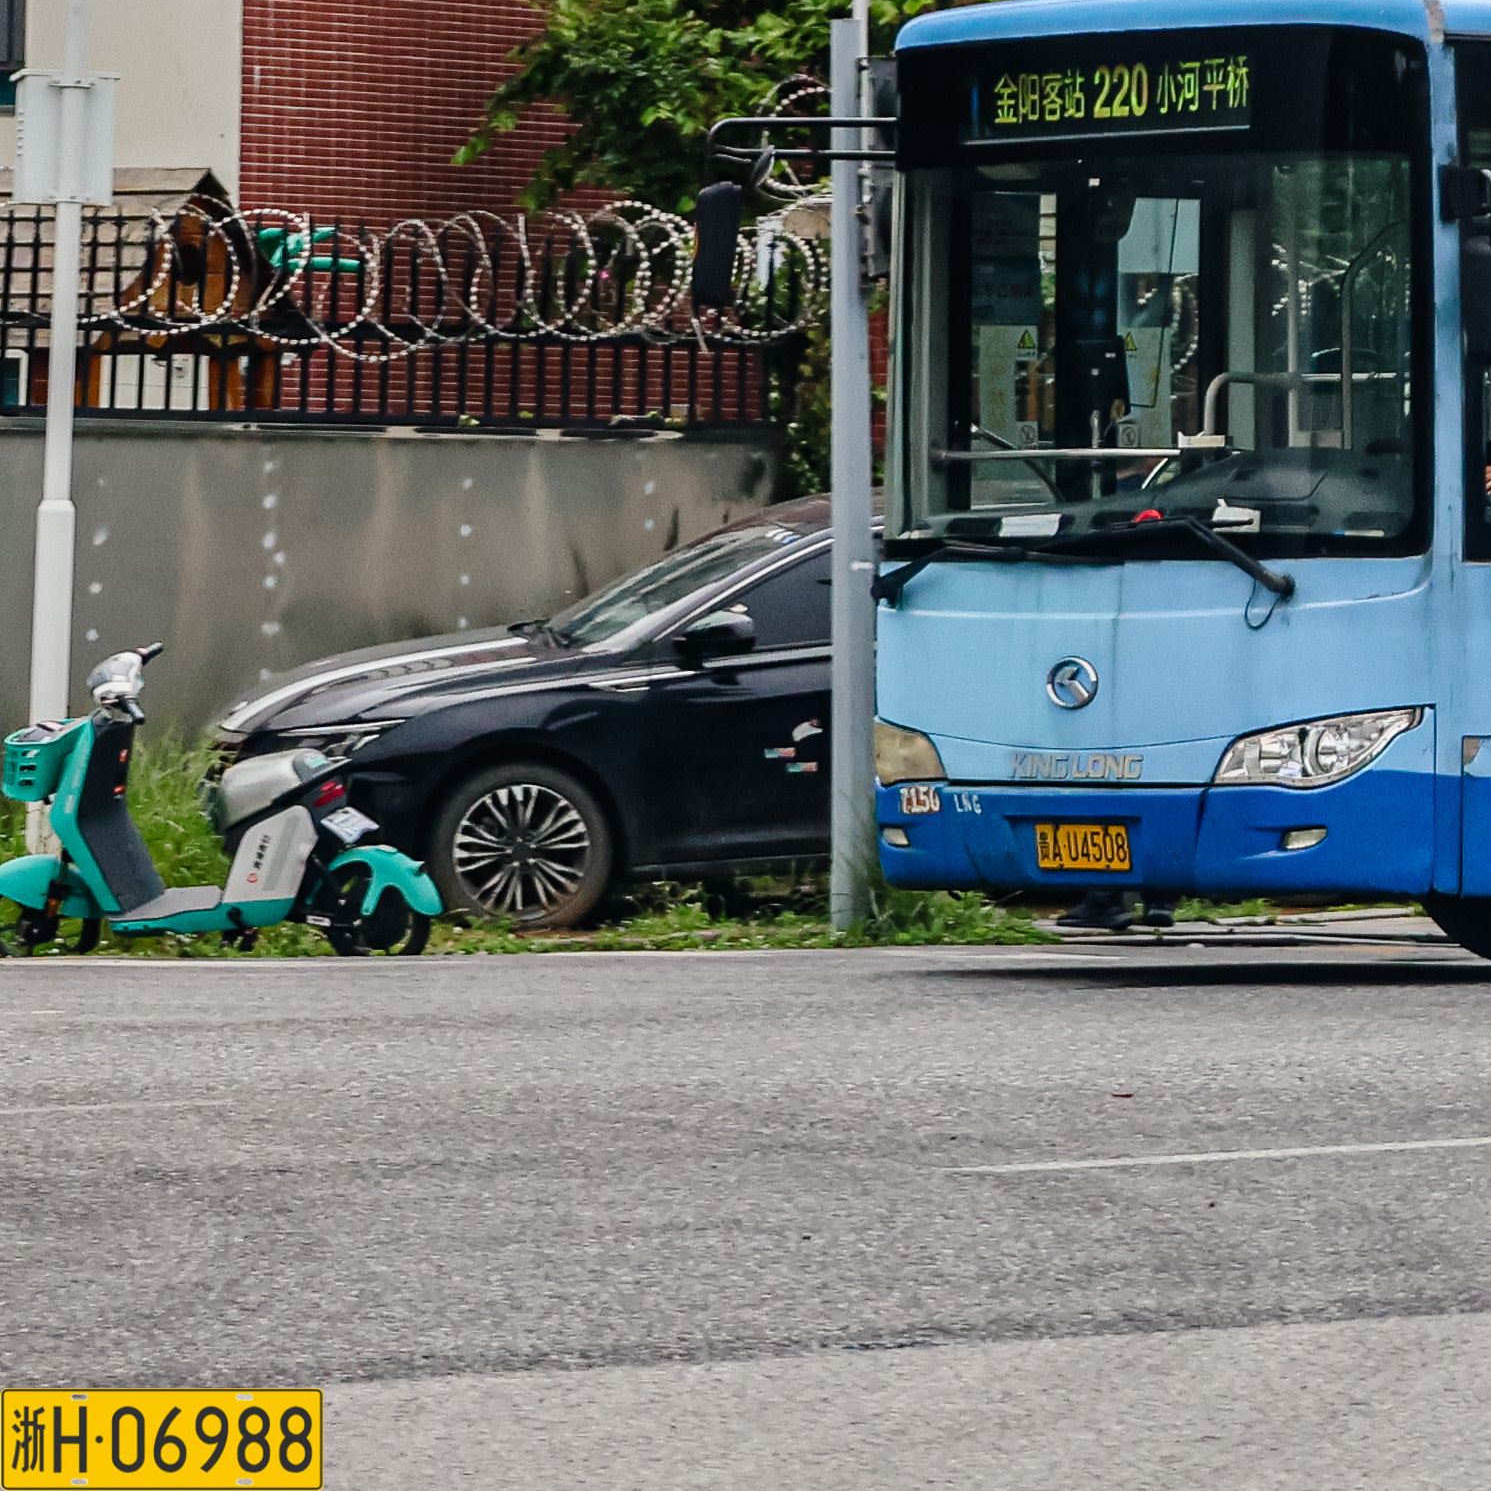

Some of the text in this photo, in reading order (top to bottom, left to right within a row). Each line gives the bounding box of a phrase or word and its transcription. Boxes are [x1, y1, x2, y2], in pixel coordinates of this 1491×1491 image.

[994, 55, 1250, 125] 金阳客站 220 小河平桥
[1010, 754, 1143, 779] KING LONG
